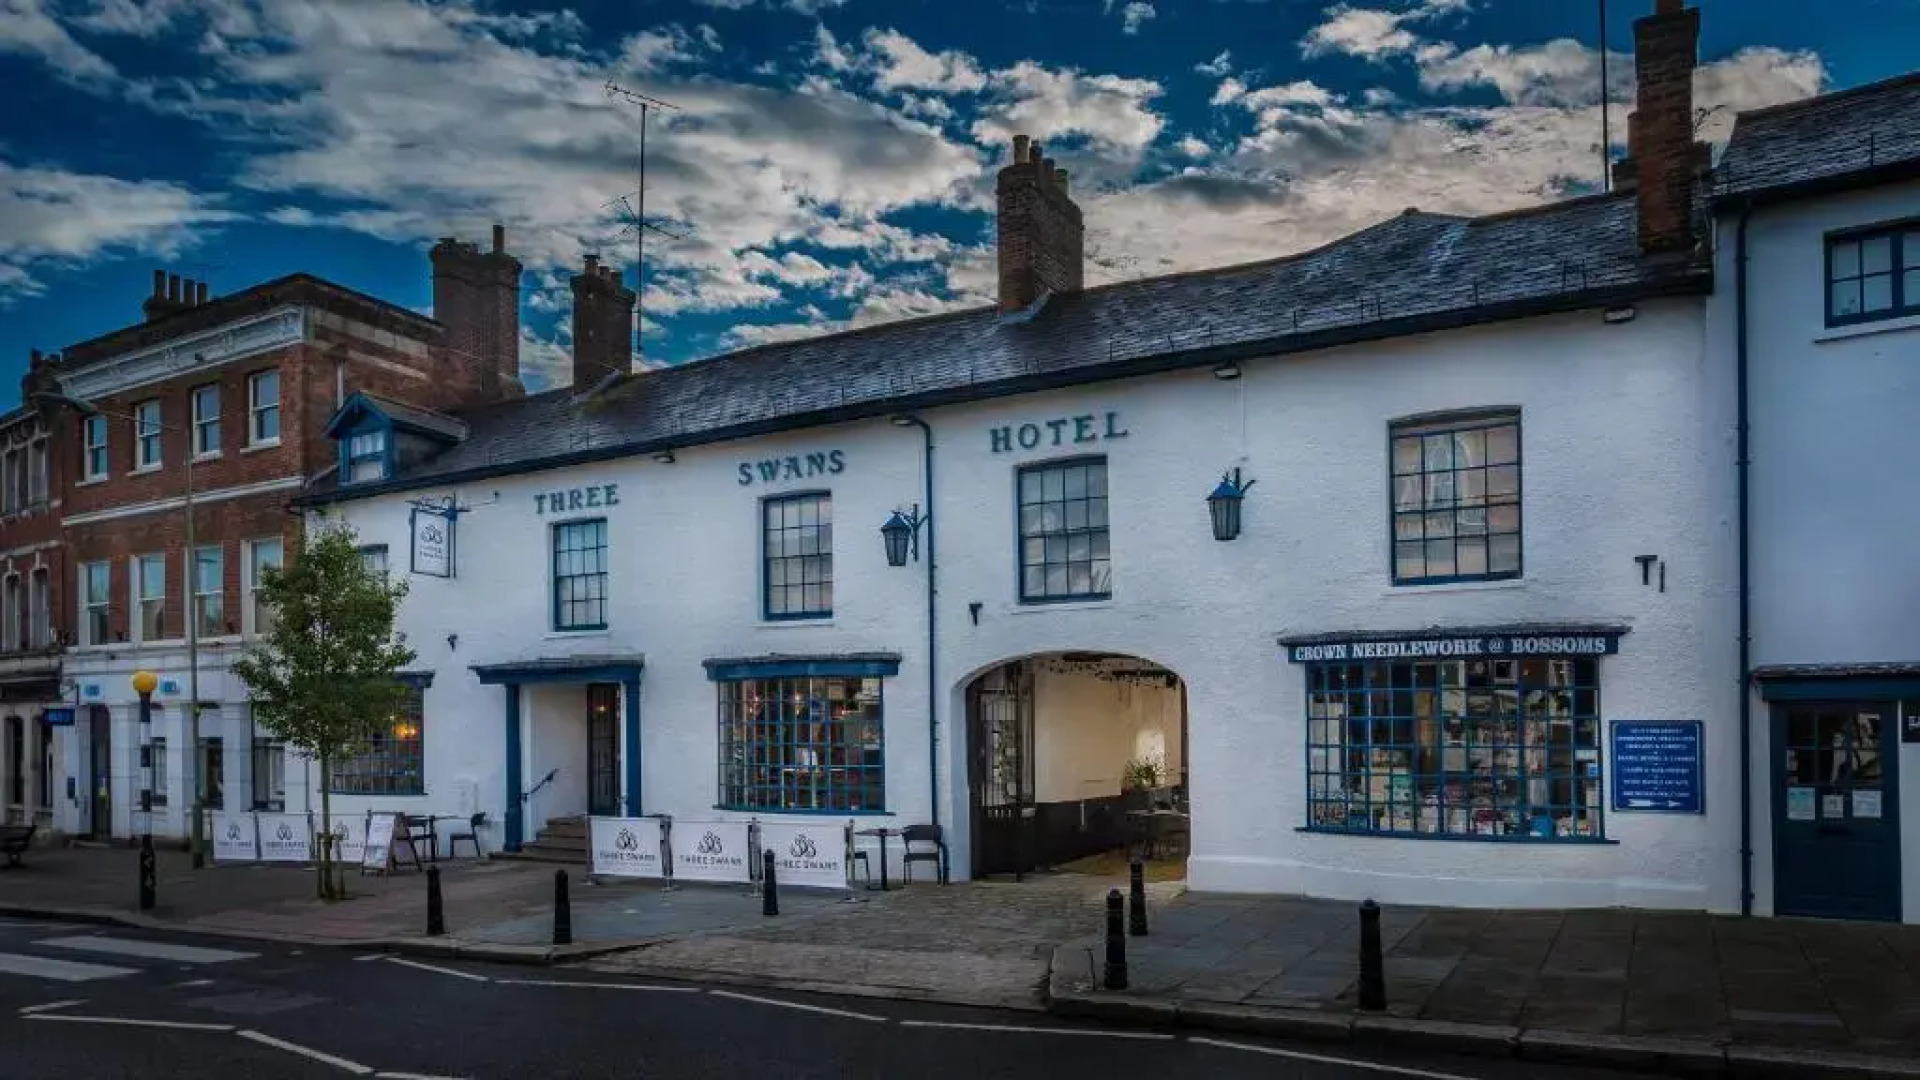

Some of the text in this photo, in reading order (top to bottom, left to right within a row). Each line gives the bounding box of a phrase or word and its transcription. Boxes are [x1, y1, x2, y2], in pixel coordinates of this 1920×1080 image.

[533, 411, 1129, 515] THREE SWANS HOTEL
[1295, 636, 1606, 661] CROWN NEEDLEWORK @ BOSSOMS
[680, 854, 742, 866] THREE SWANS
